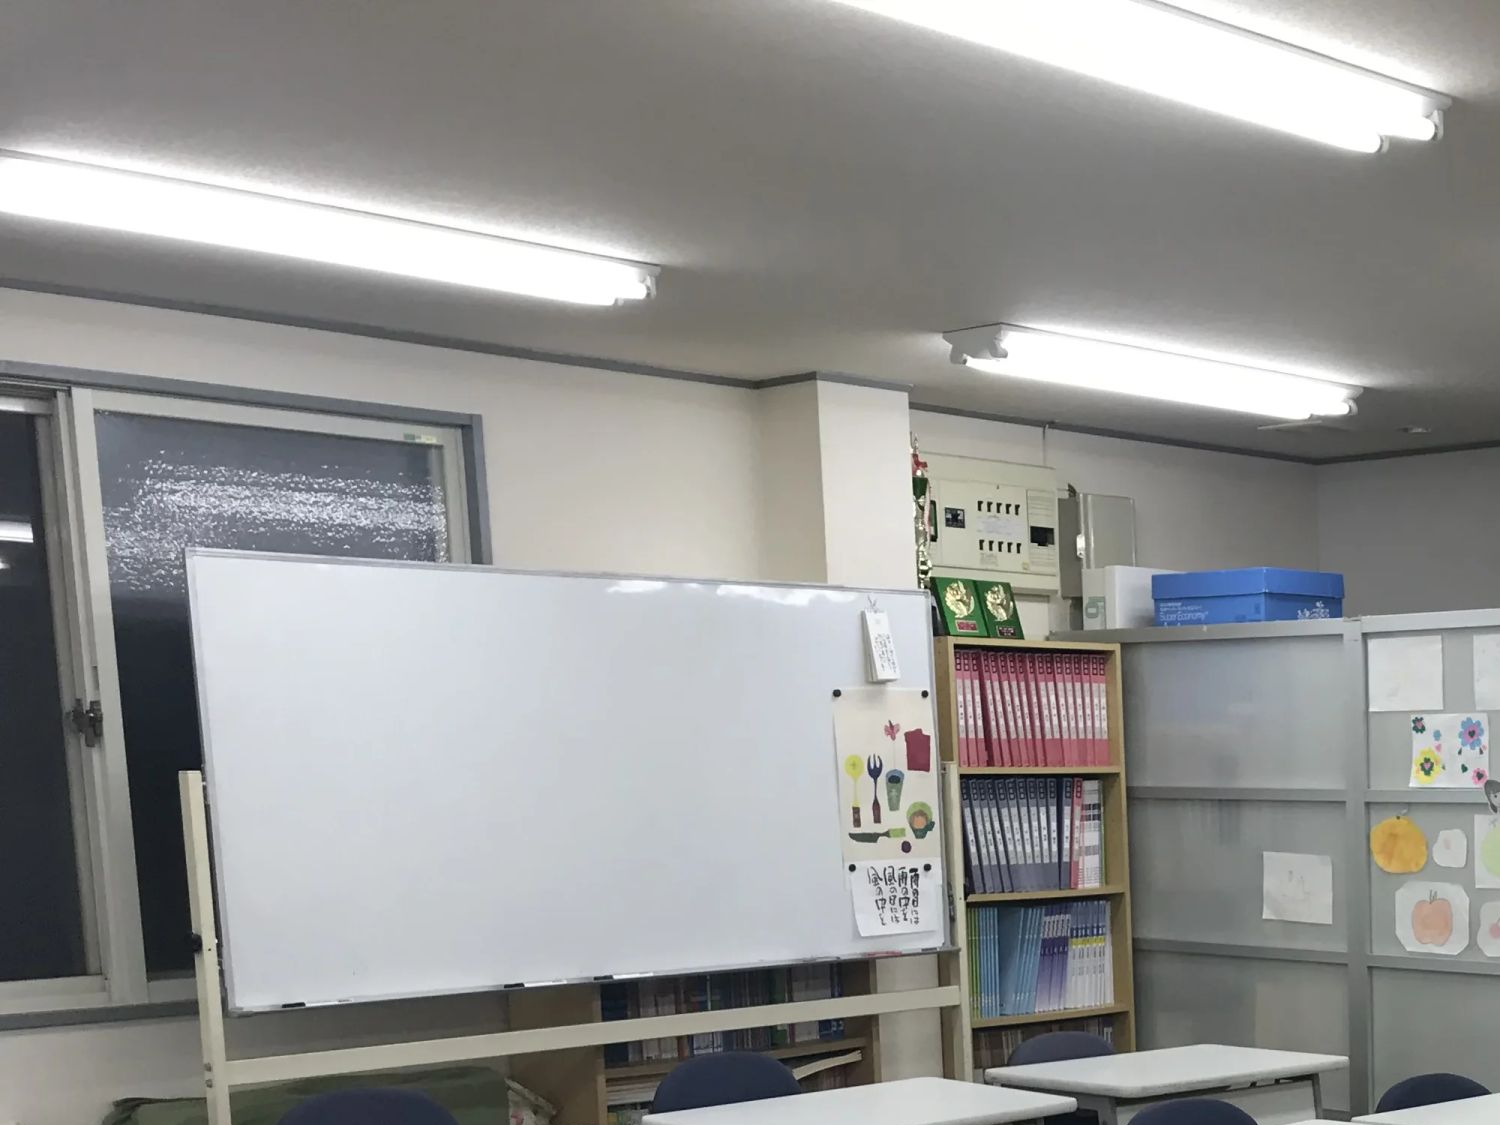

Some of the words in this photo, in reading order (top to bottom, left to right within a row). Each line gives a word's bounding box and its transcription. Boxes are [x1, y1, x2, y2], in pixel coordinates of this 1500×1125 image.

[867, 866, 887, 926] 風の中を
[883, 865, 900, 924] 風の日には
[898, 866, 910, 922] 雨の中を
[909, 867, 920, 925] 雨の日には
